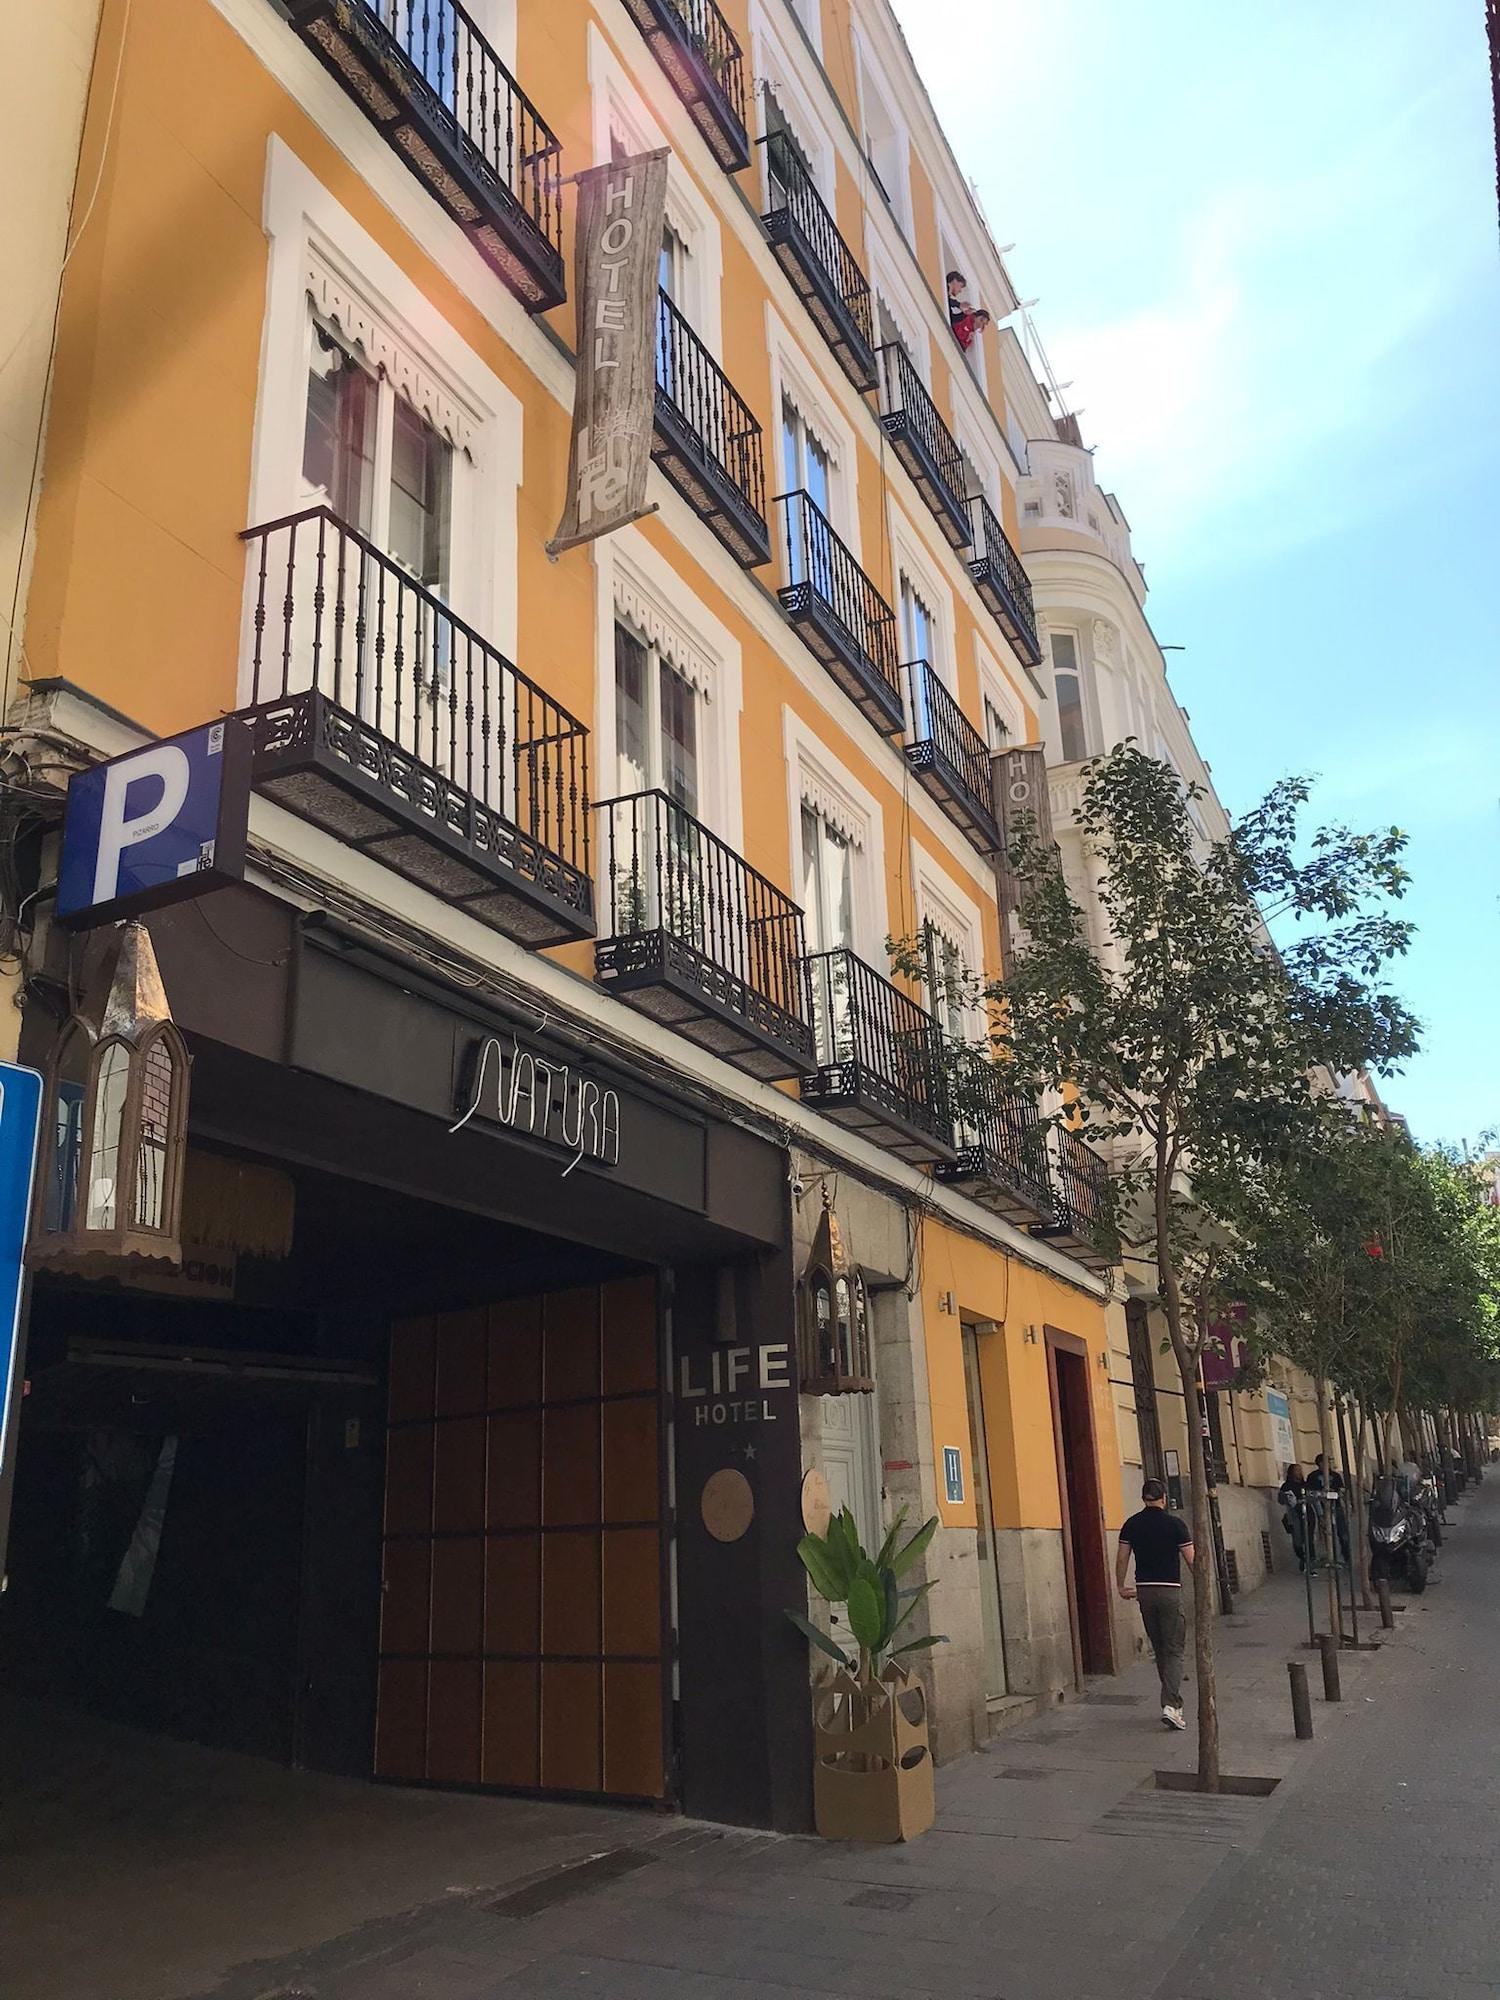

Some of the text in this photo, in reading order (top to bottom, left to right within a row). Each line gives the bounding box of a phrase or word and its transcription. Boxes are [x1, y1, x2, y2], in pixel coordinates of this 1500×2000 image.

[594, 177, 634, 371] HOTEL
[92, 745, 190, 906] P
[132, 823, 160, 838] PIZARRO
[448, 1031, 620, 1178] NATURA
[681, 1344, 790, 1398] LIFE
[695, 1400, 777, 1426] HOTEL
